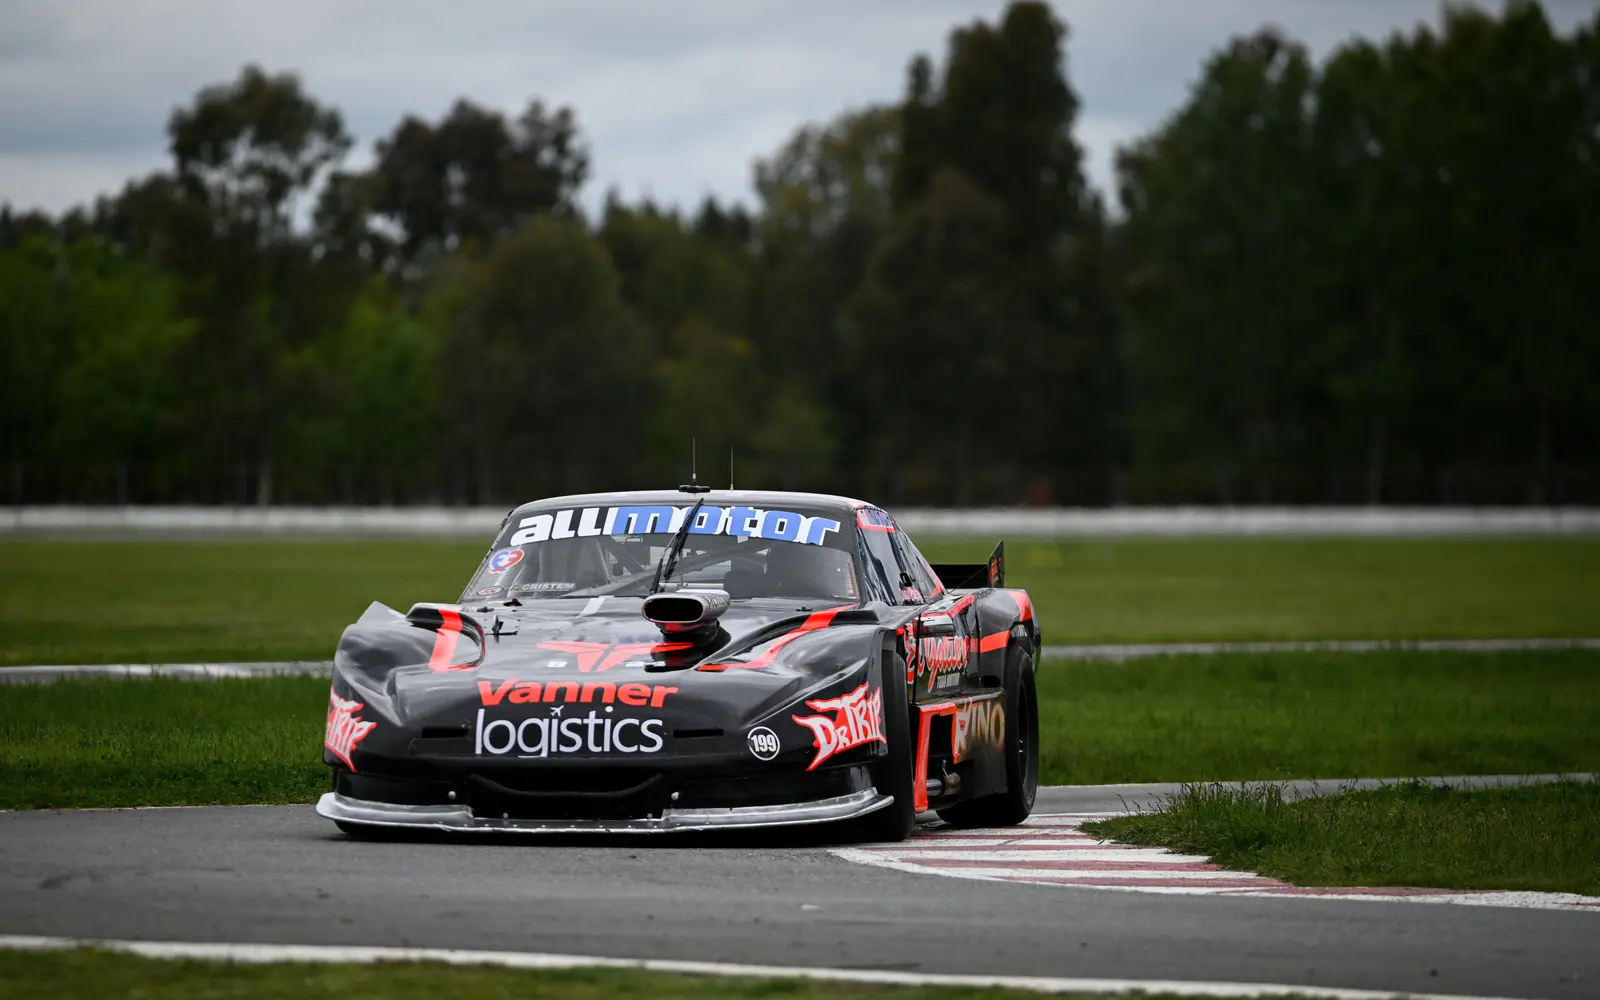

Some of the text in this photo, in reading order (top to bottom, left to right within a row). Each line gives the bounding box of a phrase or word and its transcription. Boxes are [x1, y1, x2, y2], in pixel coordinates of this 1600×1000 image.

[510, 505, 841, 547] allmotor
[477, 678, 679, 708] Vanner
[475, 706, 664, 758] logistics
[750, 734, 777, 752] 199
